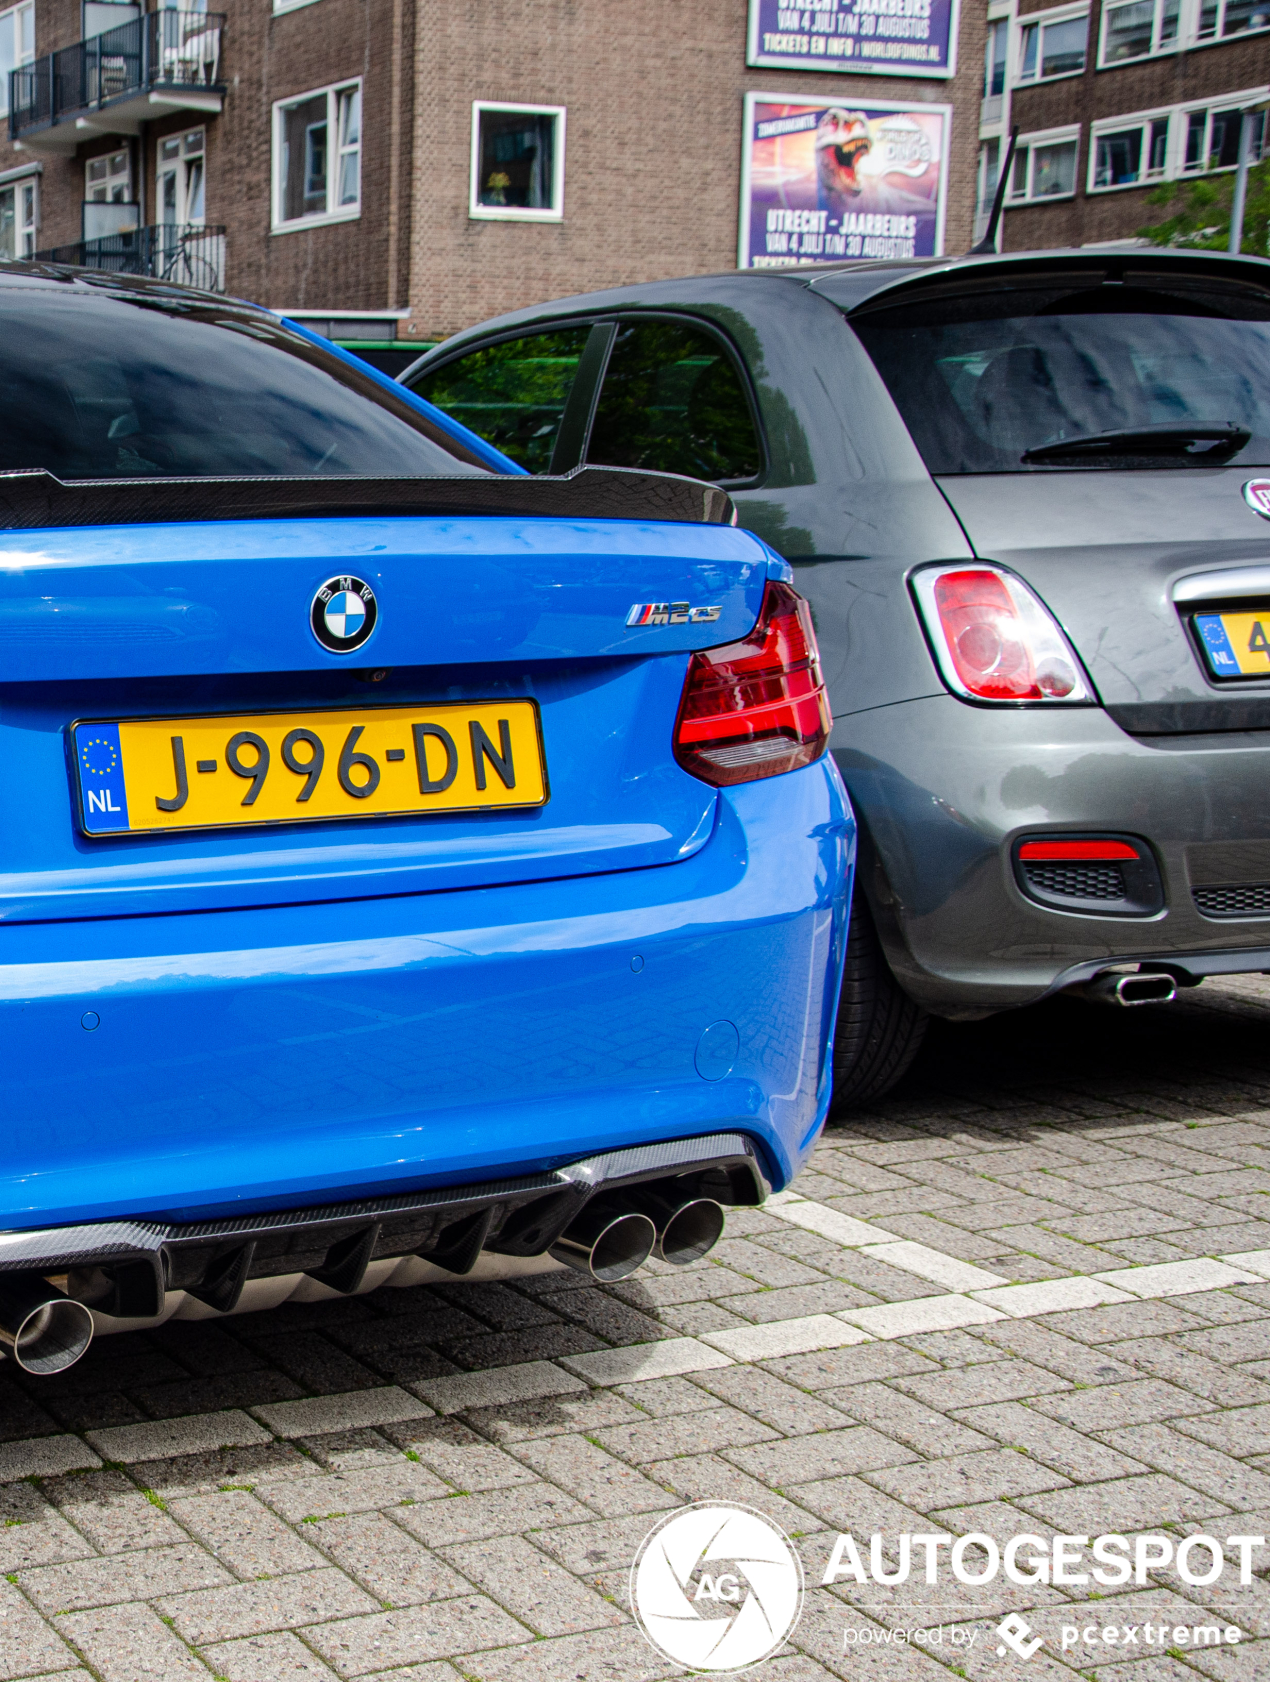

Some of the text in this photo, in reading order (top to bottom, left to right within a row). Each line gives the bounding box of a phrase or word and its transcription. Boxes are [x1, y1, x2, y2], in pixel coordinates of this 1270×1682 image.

[777, 9, 930, 39] VAN 4 JULI T/M 30 AUGUSTUS
[763, 33, 809, 54] TICKETS
[810, 35, 826, 55] EN
[827, 36, 854, 57] INFO
[766, 209, 828, 233] UTRECHT
[838, 212, 917, 238] JAARBEURS
[766, 232, 915, 259] VAN 4 JULI T/M 30 AUGUSTUS
[318, 577, 373, 603] BMW
[1211, 651, 1234, 665] NL
[155, 719, 516, 812] J-996-DN
[88, 789, 121, 813] NL
